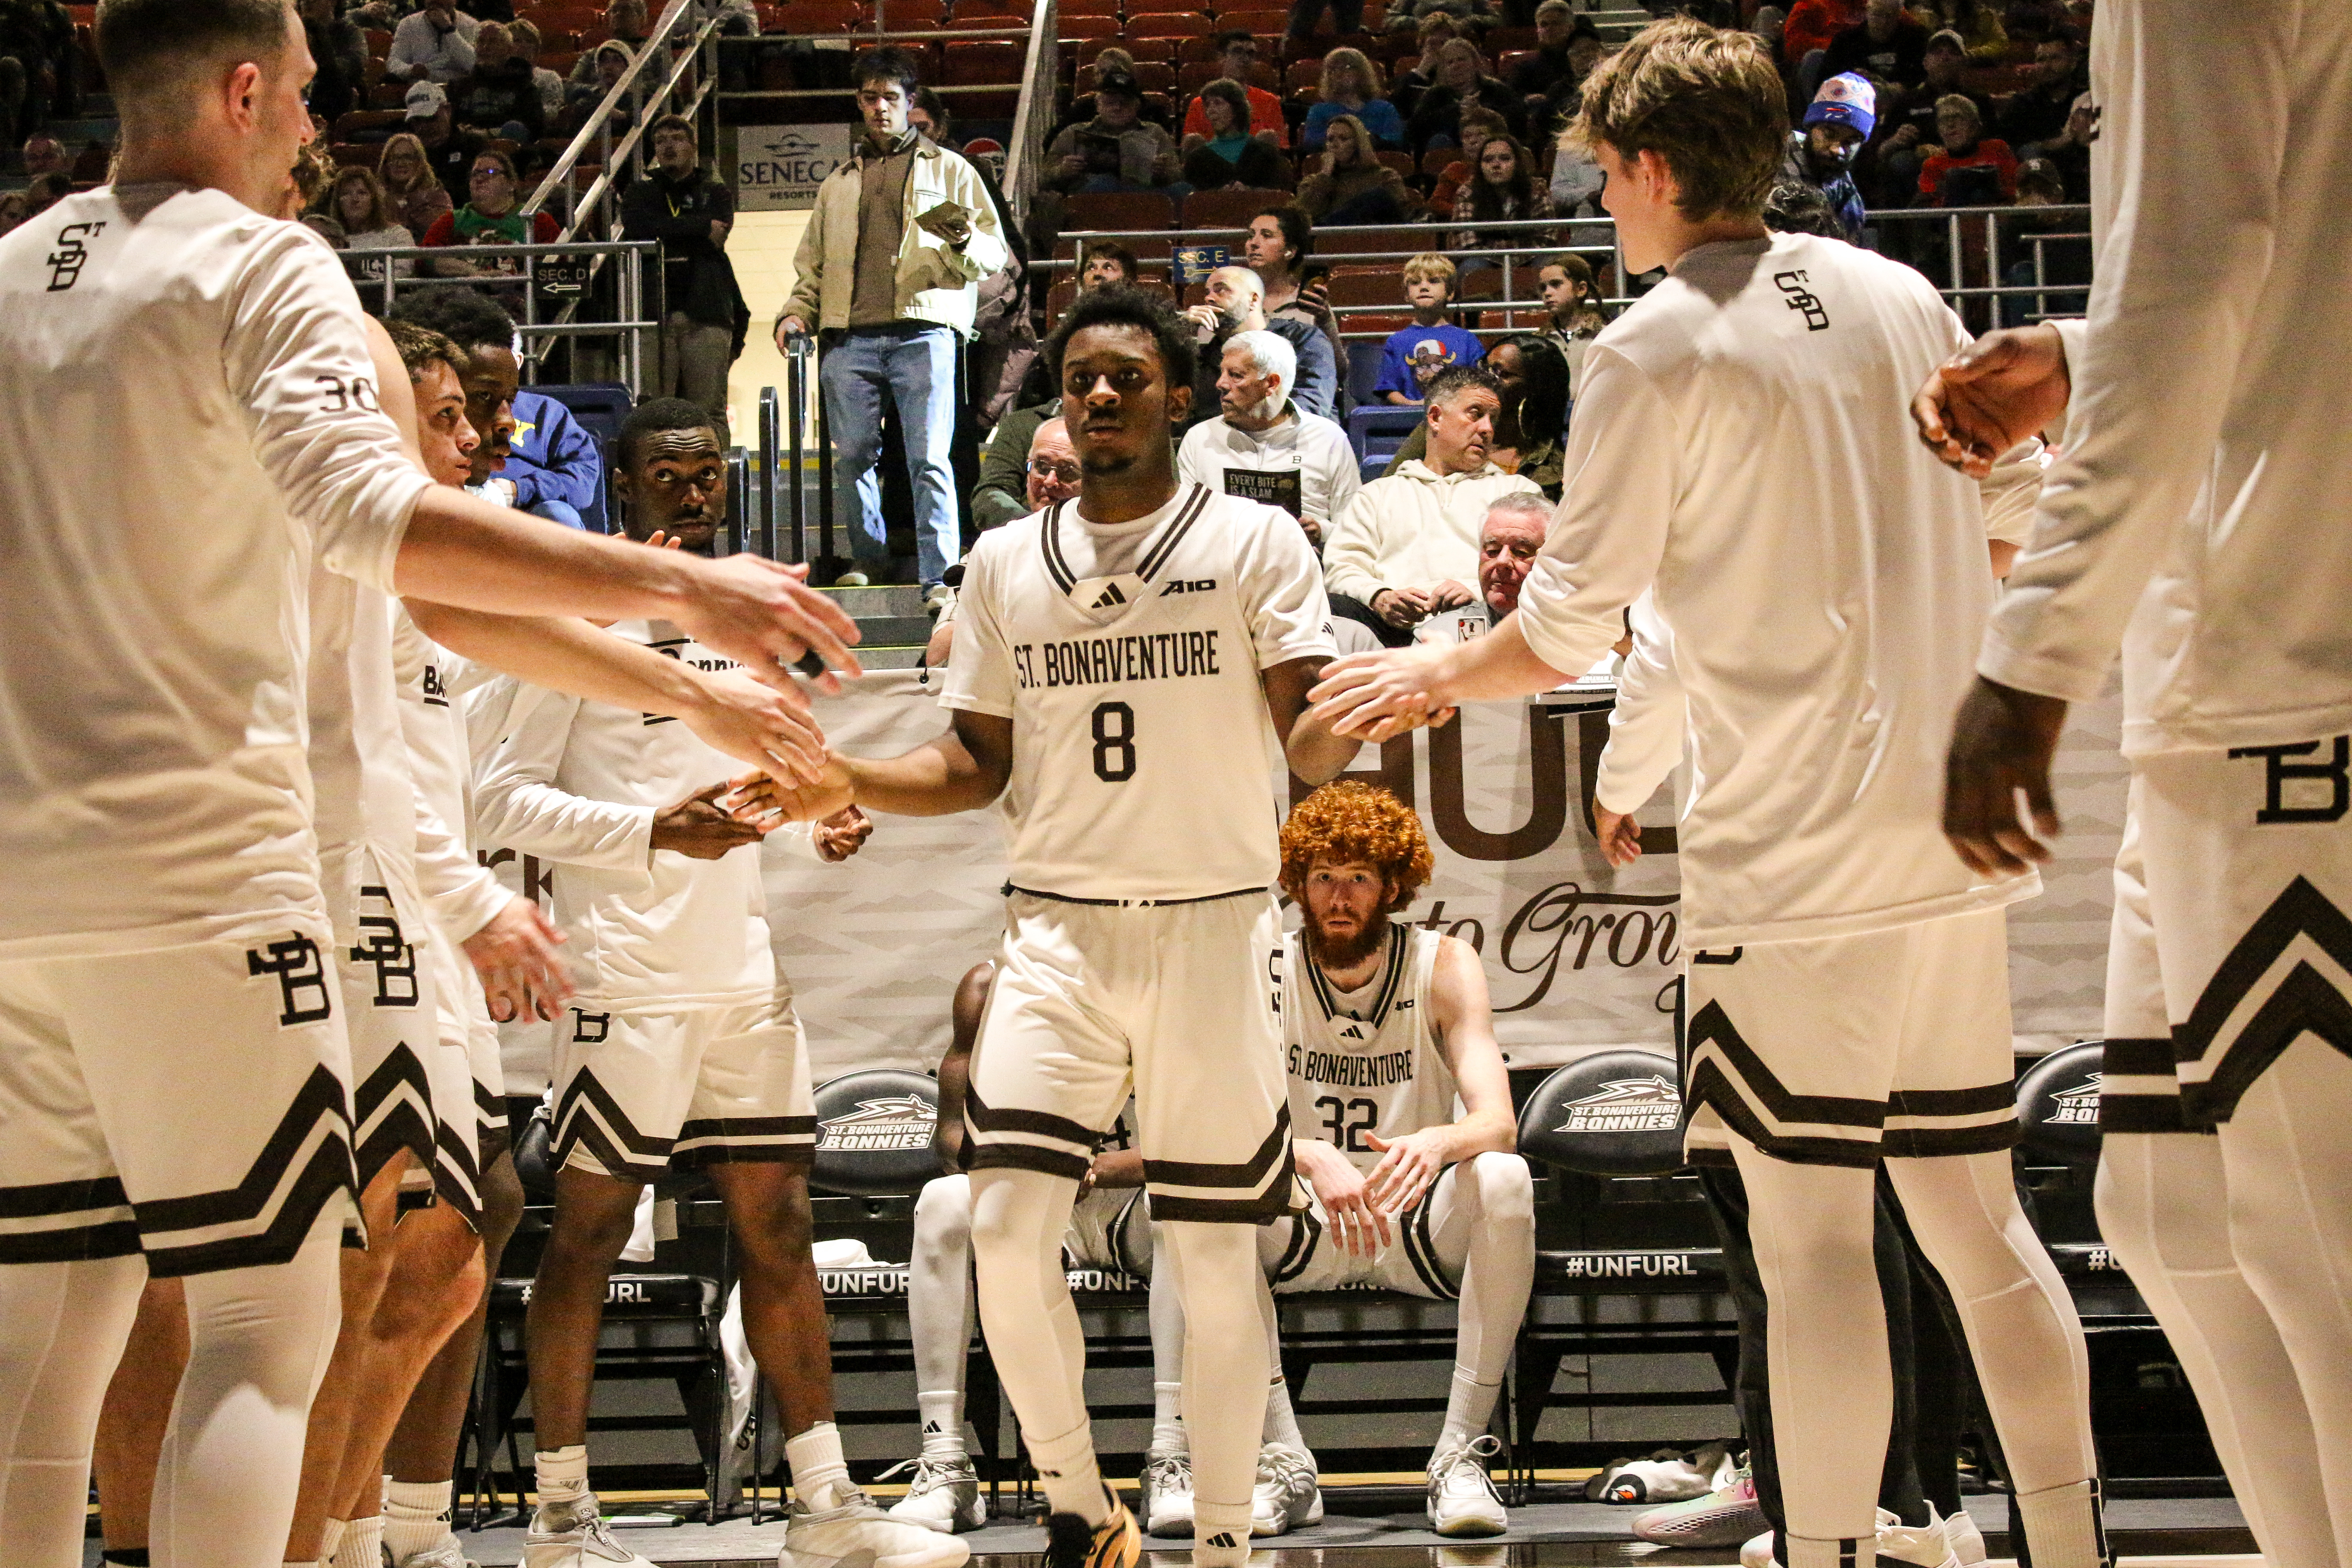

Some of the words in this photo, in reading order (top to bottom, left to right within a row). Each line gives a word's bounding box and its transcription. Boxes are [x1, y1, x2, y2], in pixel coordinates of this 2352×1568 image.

[1215, 250, 1224, 263] E
[576, 268, 586, 280] D
[1229, 474, 1256, 487] EVERY
[1258, 476, 1276, 488] BITE
[1159, 579, 1216, 597] A10
[1014, 643, 1041, 689] ST.
[1047, 630, 1220, 688] BONAVENTURE
[1092, 701, 1136, 782] 8
[1304, 1049, 1413, 1087] BONAVENTURE
[1315, 1095, 1378, 1152] 32
[1567, 1114, 1676, 1130] BONNIES
[822, 1133, 930, 1149] BONNIES
[1566, 1255, 1697, 1278] #UNFURL
[818, 1272, 910, 1294] UNFUR
[1066, 1270, 1150, 1291] #UNF
